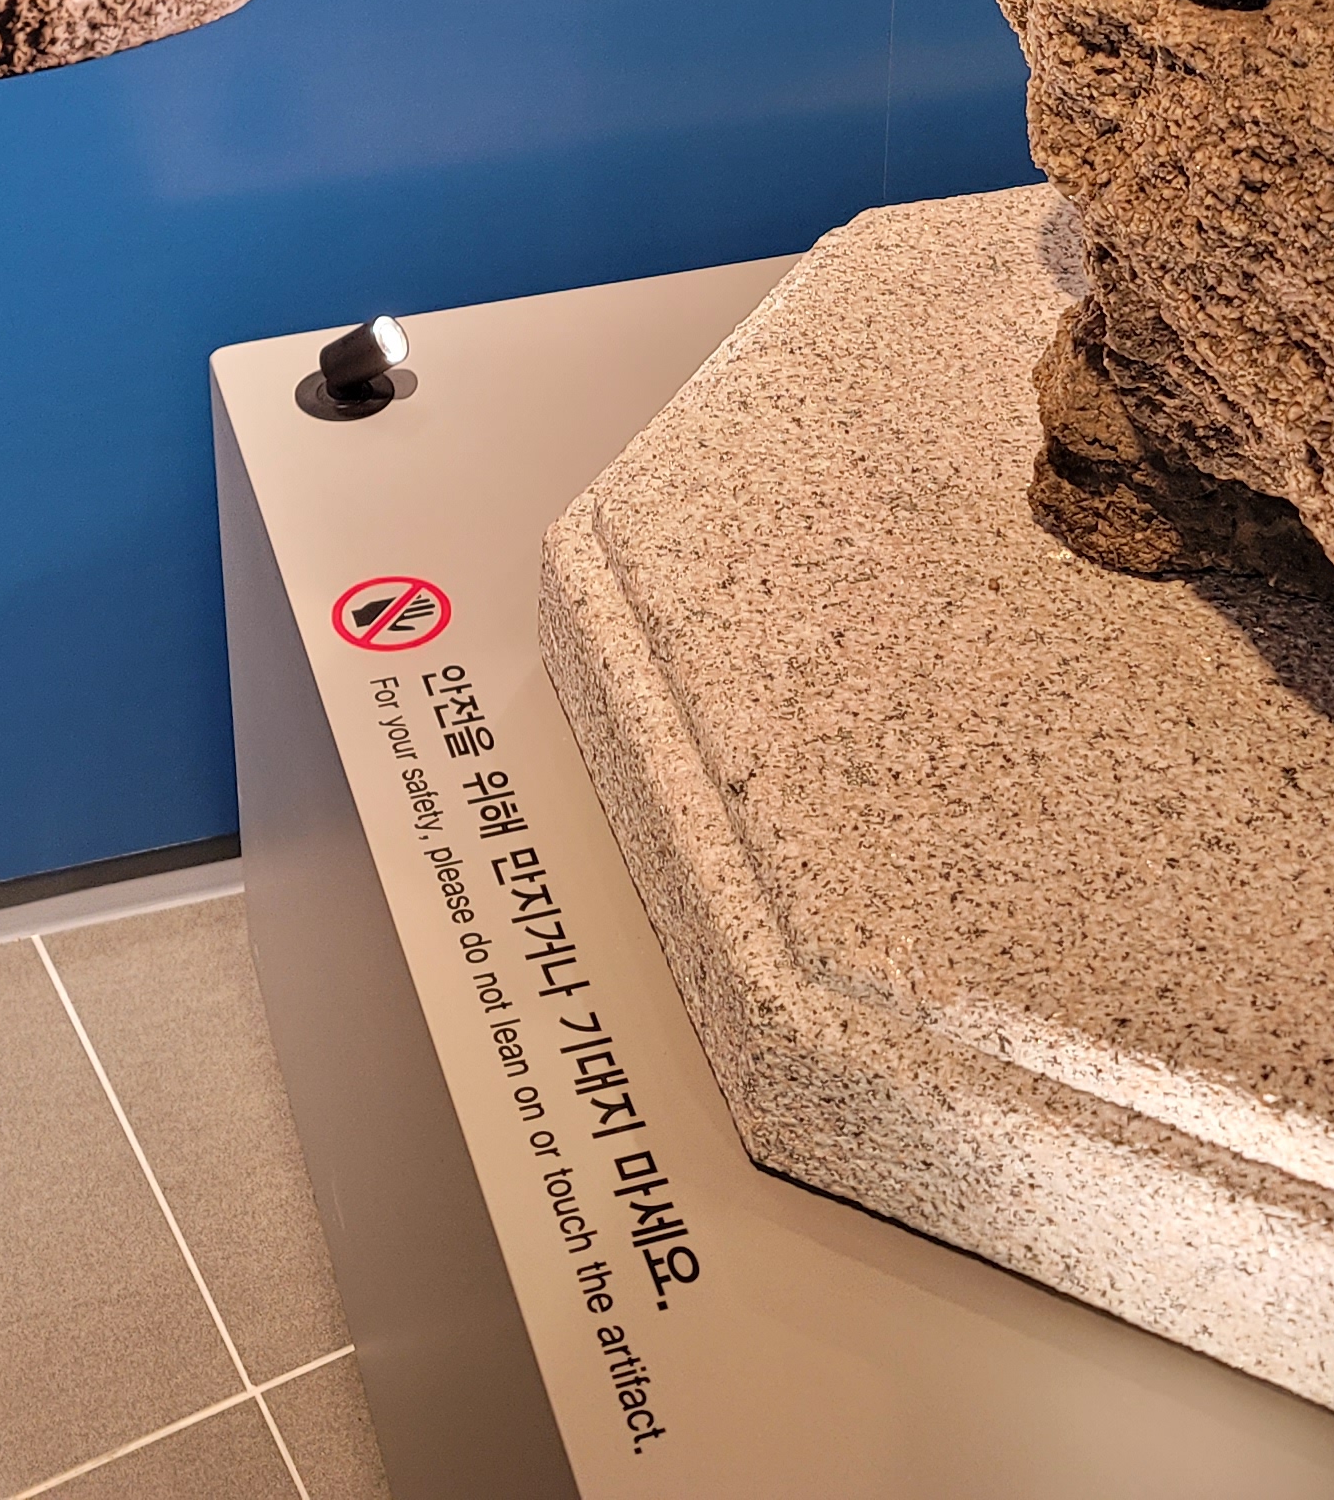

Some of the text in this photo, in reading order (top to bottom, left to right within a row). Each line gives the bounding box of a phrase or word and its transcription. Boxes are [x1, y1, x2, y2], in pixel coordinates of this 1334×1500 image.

[369, 676, 667, 1456] For your safety, please do not lean on or touch the artifact.
[421, 664, 700, 1312] 안전을 위해 만지거나 기대지 마세요.
